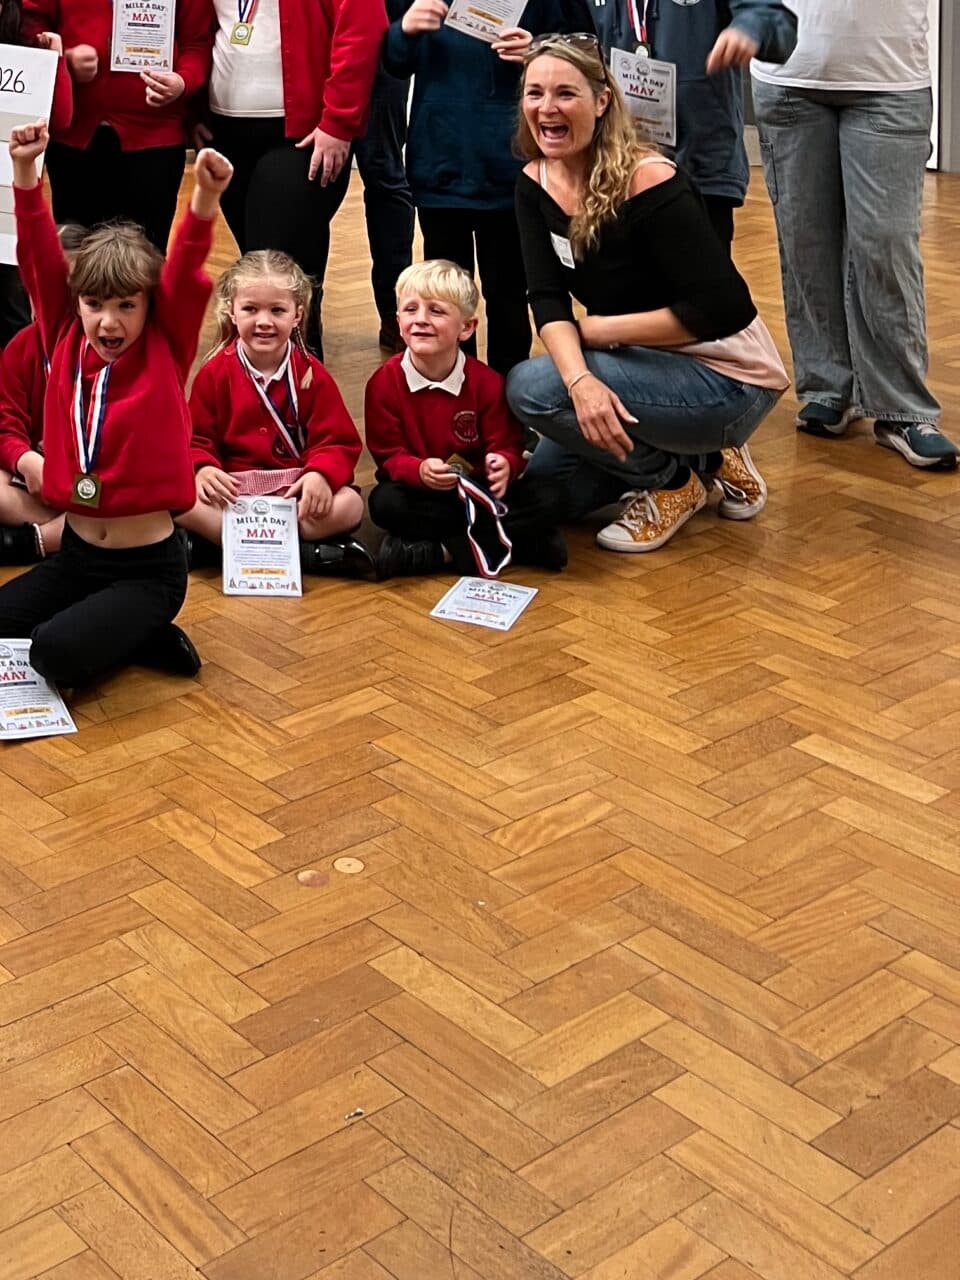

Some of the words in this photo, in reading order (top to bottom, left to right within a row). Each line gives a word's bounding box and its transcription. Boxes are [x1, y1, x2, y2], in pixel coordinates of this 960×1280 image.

[132, 13, 156, 22] MAY
[630, 84, 655, 96] MAY
[270, 517, 287, 526] DAY
[247, 528, 276, 538] MAY
